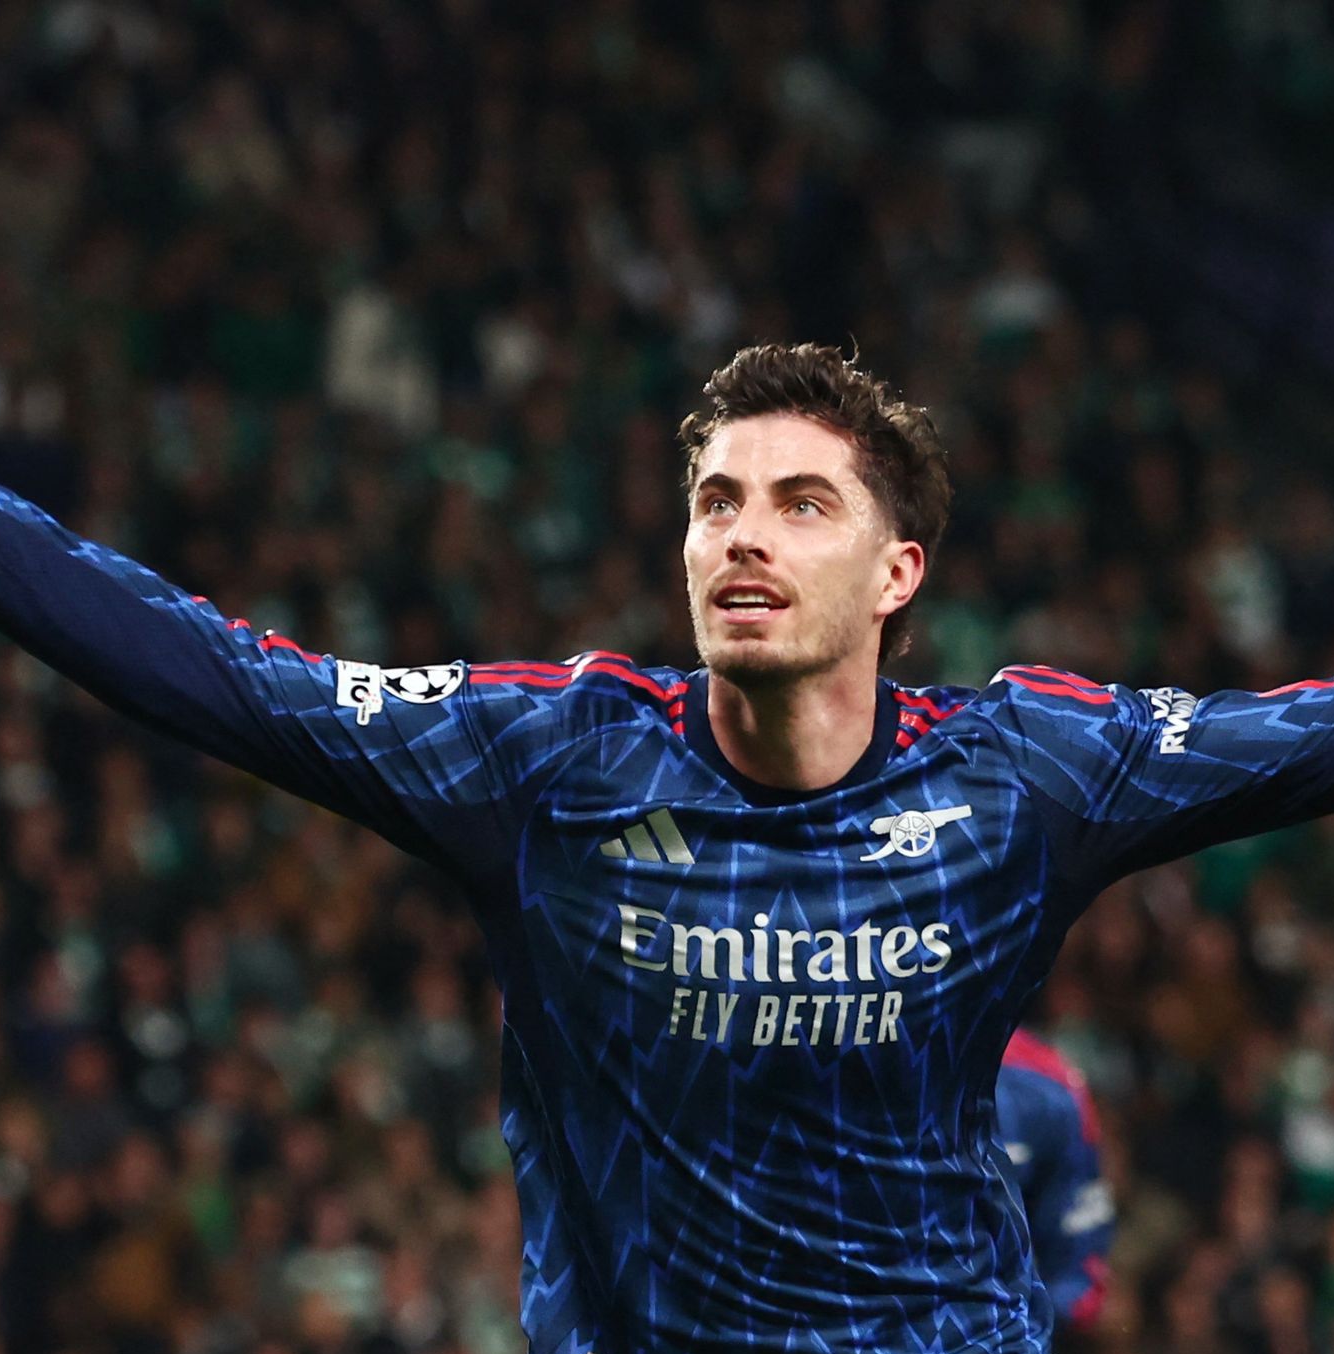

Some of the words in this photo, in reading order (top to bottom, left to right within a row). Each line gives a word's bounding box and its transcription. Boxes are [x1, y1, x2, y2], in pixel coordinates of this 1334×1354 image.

[618, 904, 952, 983] Emirates
[669, 988, 741, 1044] FLY
[752, 991, 903, 1046] BETTER
